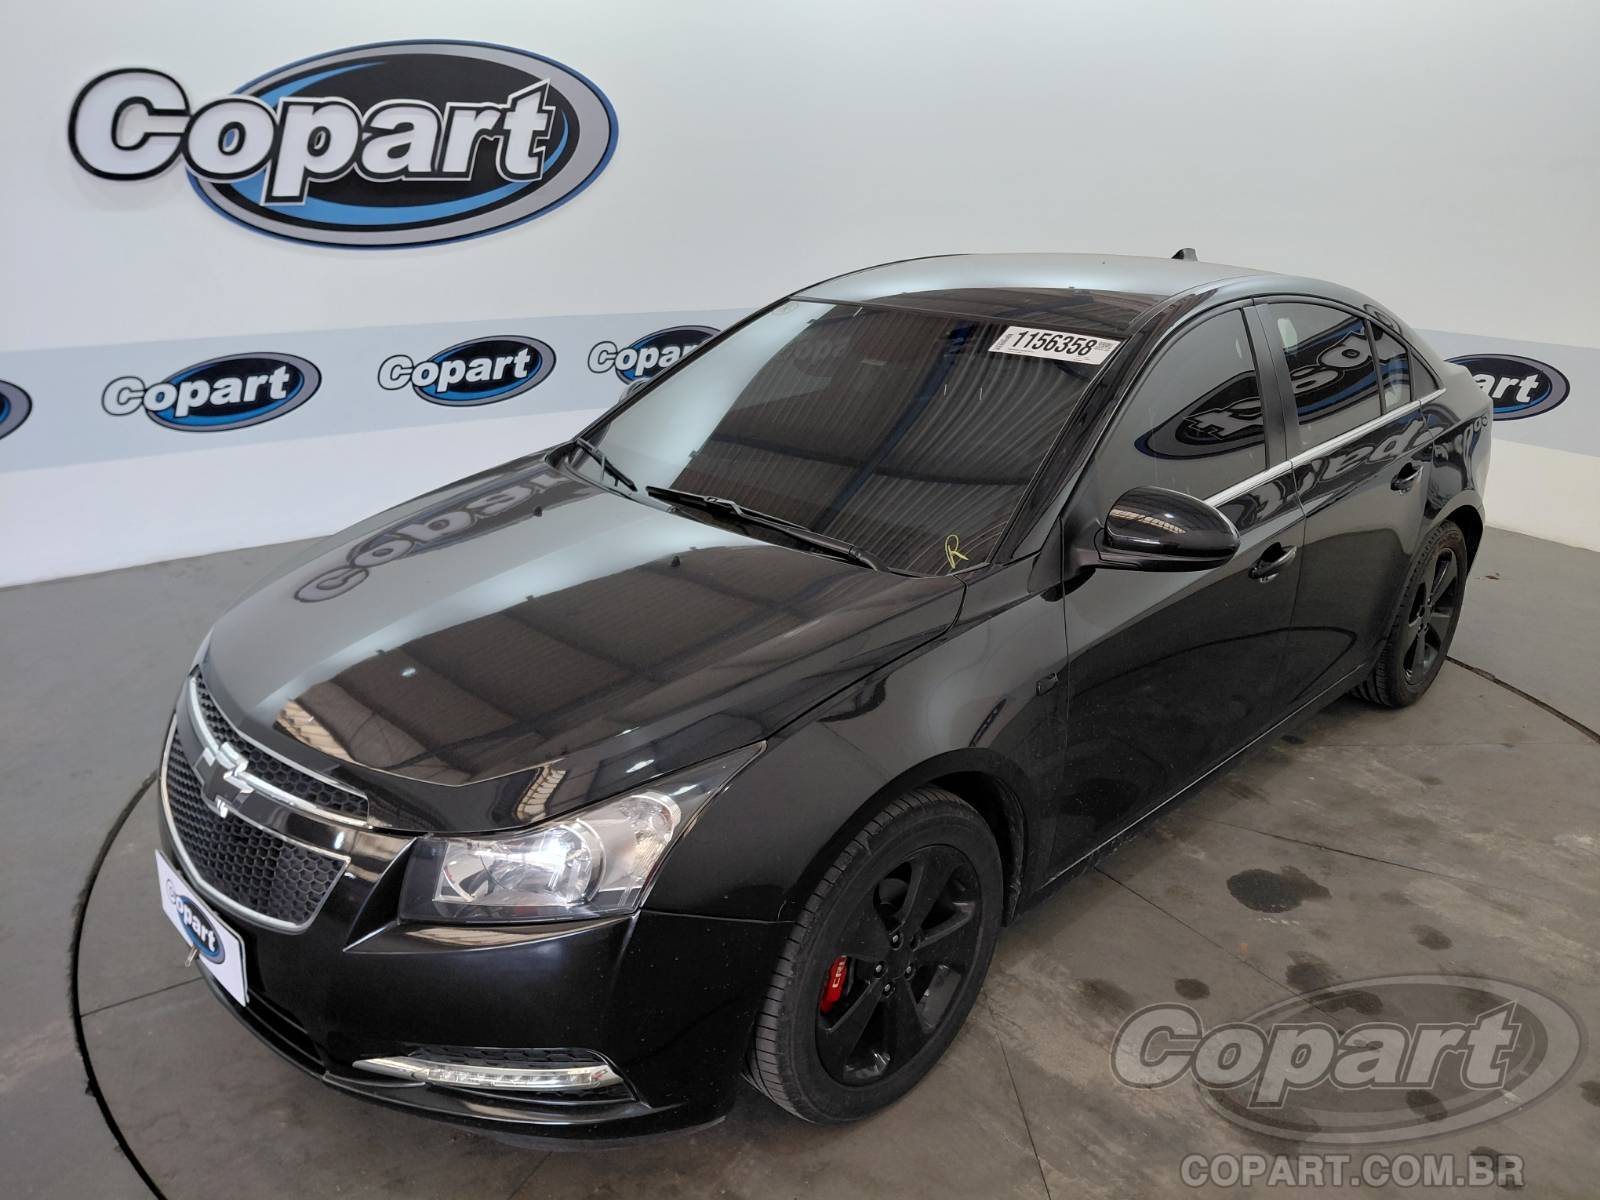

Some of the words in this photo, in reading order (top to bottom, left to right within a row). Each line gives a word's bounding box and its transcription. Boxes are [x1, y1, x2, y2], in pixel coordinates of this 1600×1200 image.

[68, 67, 555, 205] Copart
[588, 340, 700, 377] Copa
[1012, 330, 1098, 356] 1156358
[101, 365, 291, 417] Copart
[378, 348, 531, 393] Copart
[1472, 373, 1540, 403] art
[165, 878, 217, 952] Copart
